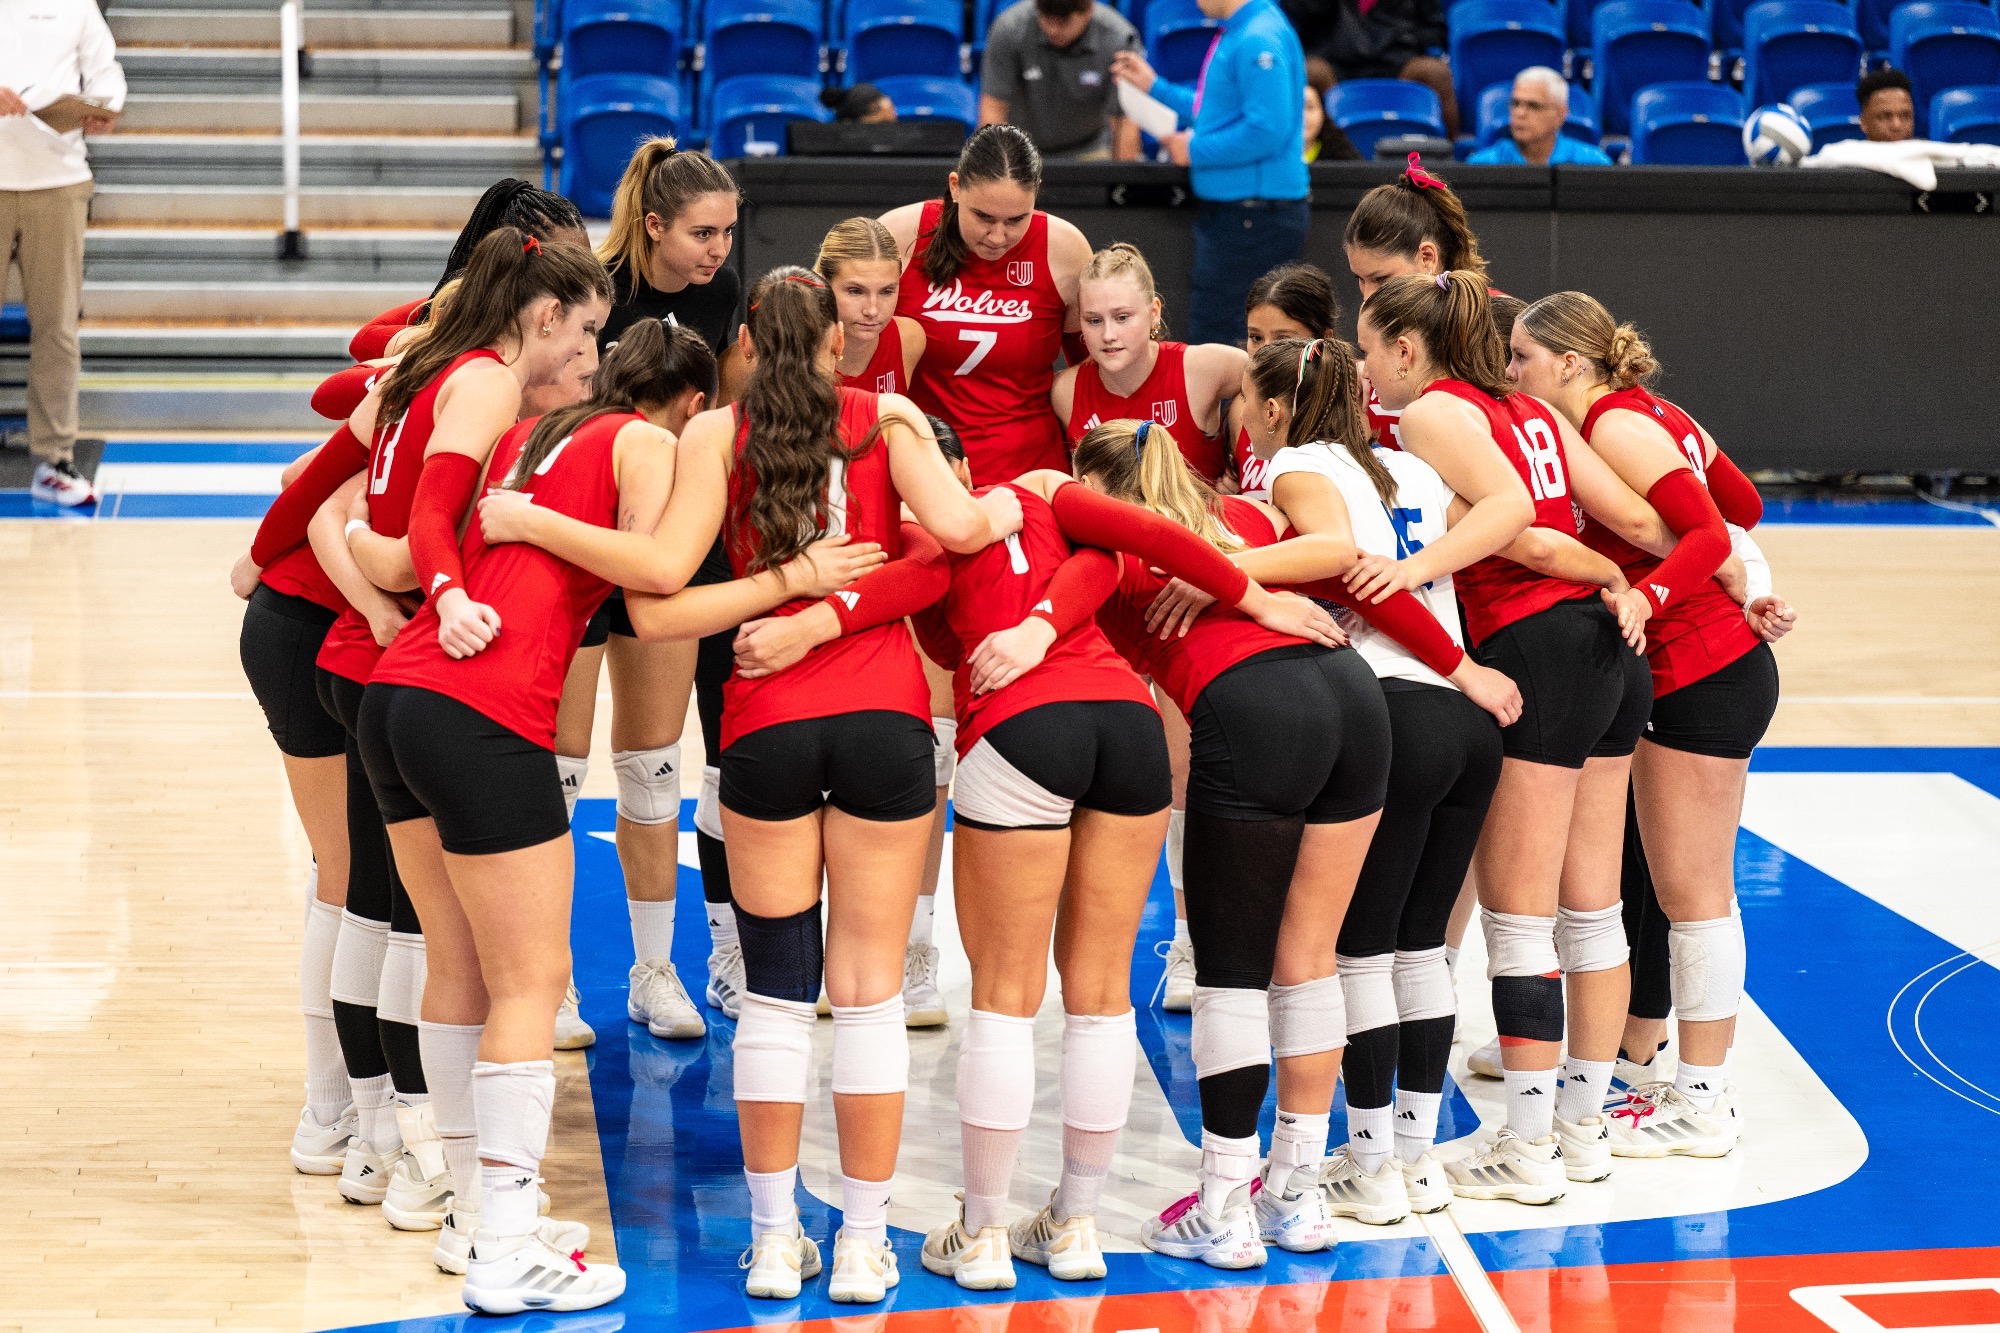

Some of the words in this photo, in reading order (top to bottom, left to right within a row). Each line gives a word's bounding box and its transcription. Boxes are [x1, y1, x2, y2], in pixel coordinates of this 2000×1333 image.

[922, 277, 1033, 318] Wolves
[953, 328, 998, 376] 7
[1510, 417, 1567, 501] 18
[1210, 1228, 1233, 1246] BELIEVE
